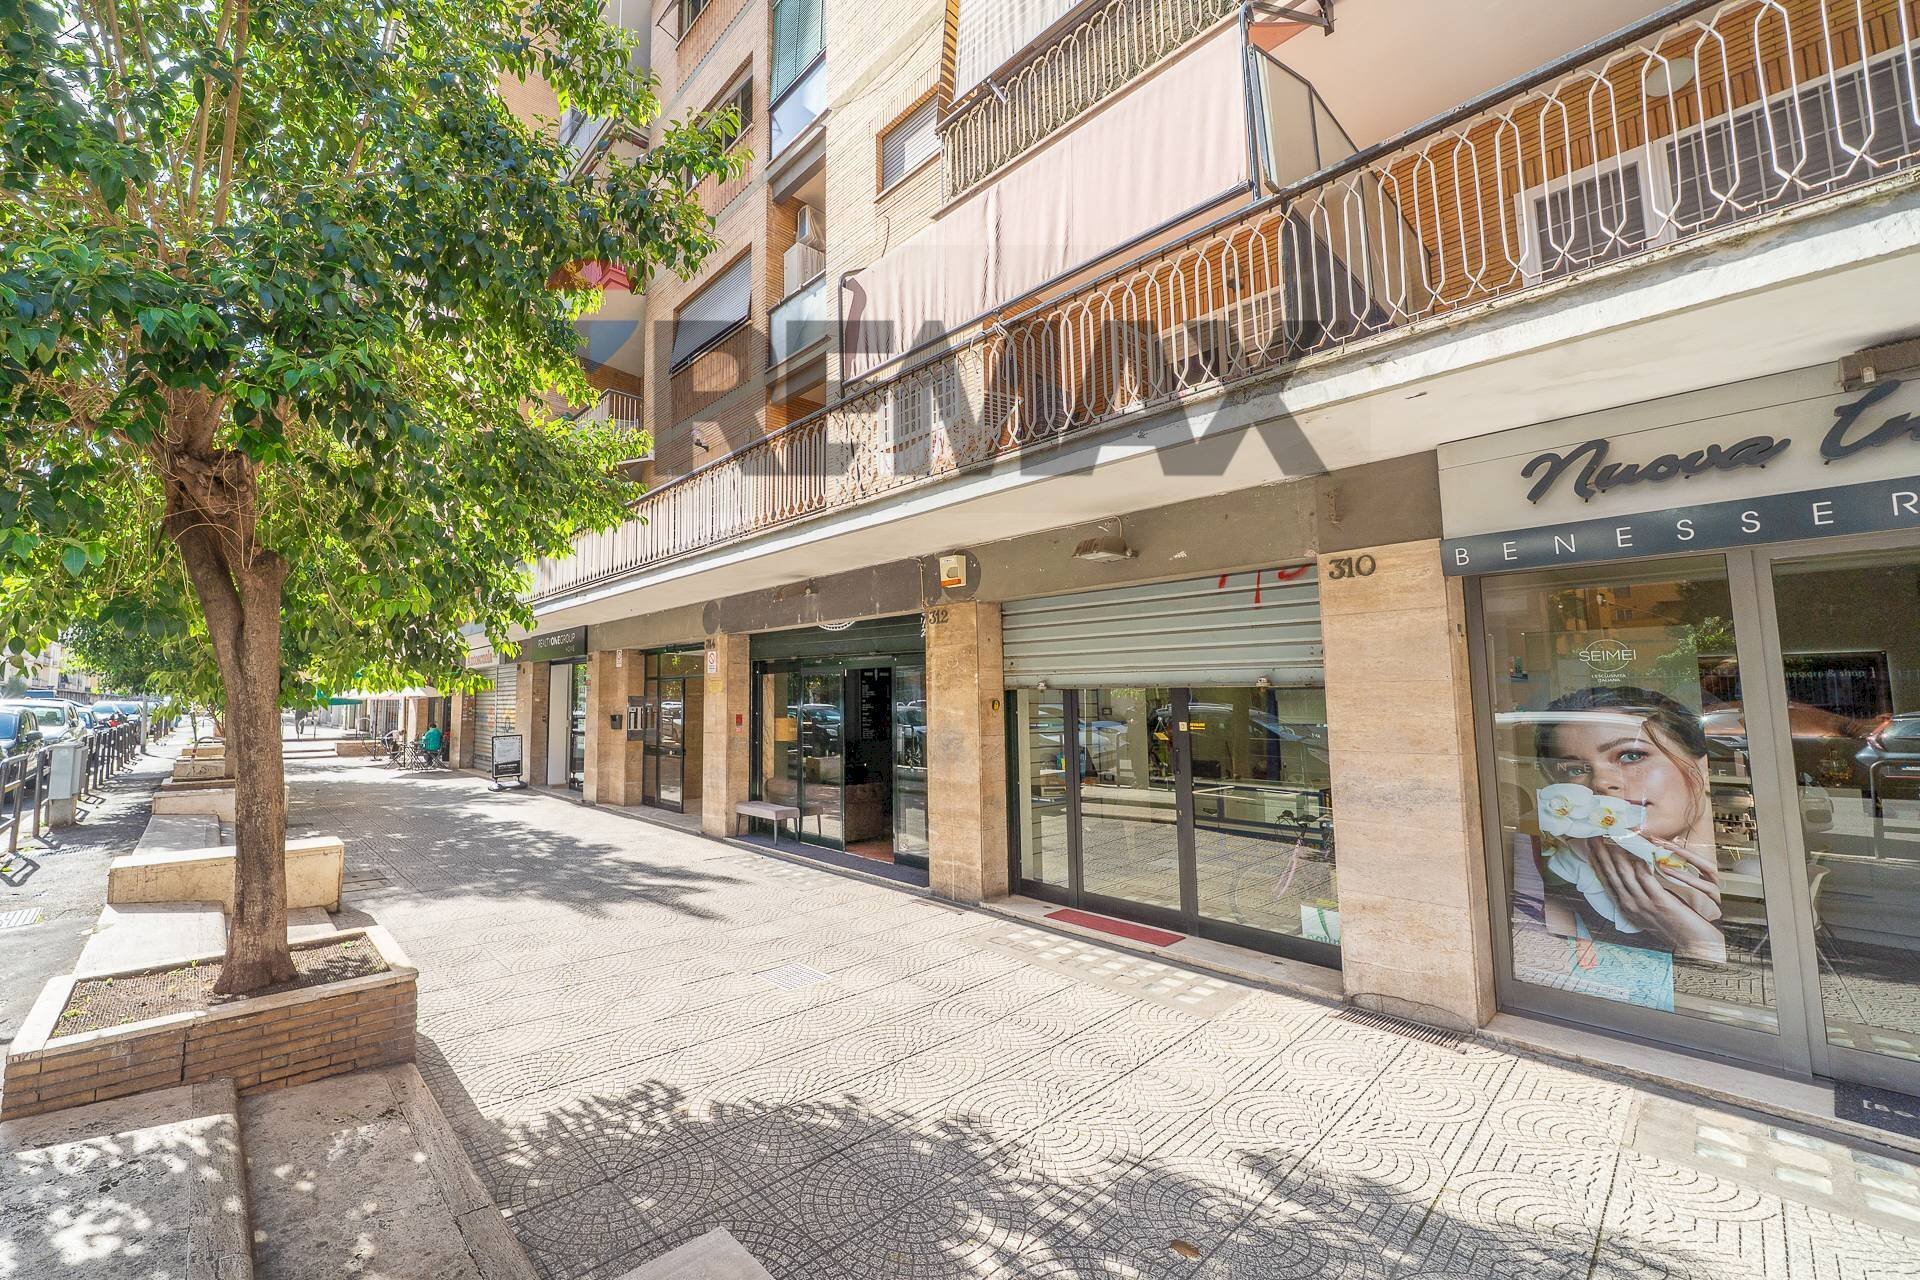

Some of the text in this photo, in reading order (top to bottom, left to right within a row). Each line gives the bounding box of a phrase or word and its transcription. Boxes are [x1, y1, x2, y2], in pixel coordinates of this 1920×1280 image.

[1521, 436, 1792, 502] Nuova
[1455, 491, 1919, 567] BENESSER
[1328, 554, 1376, 579] 310
[928, 610, 948, 624] 312
[1578, 649, 1637, 662] SEIMEI
